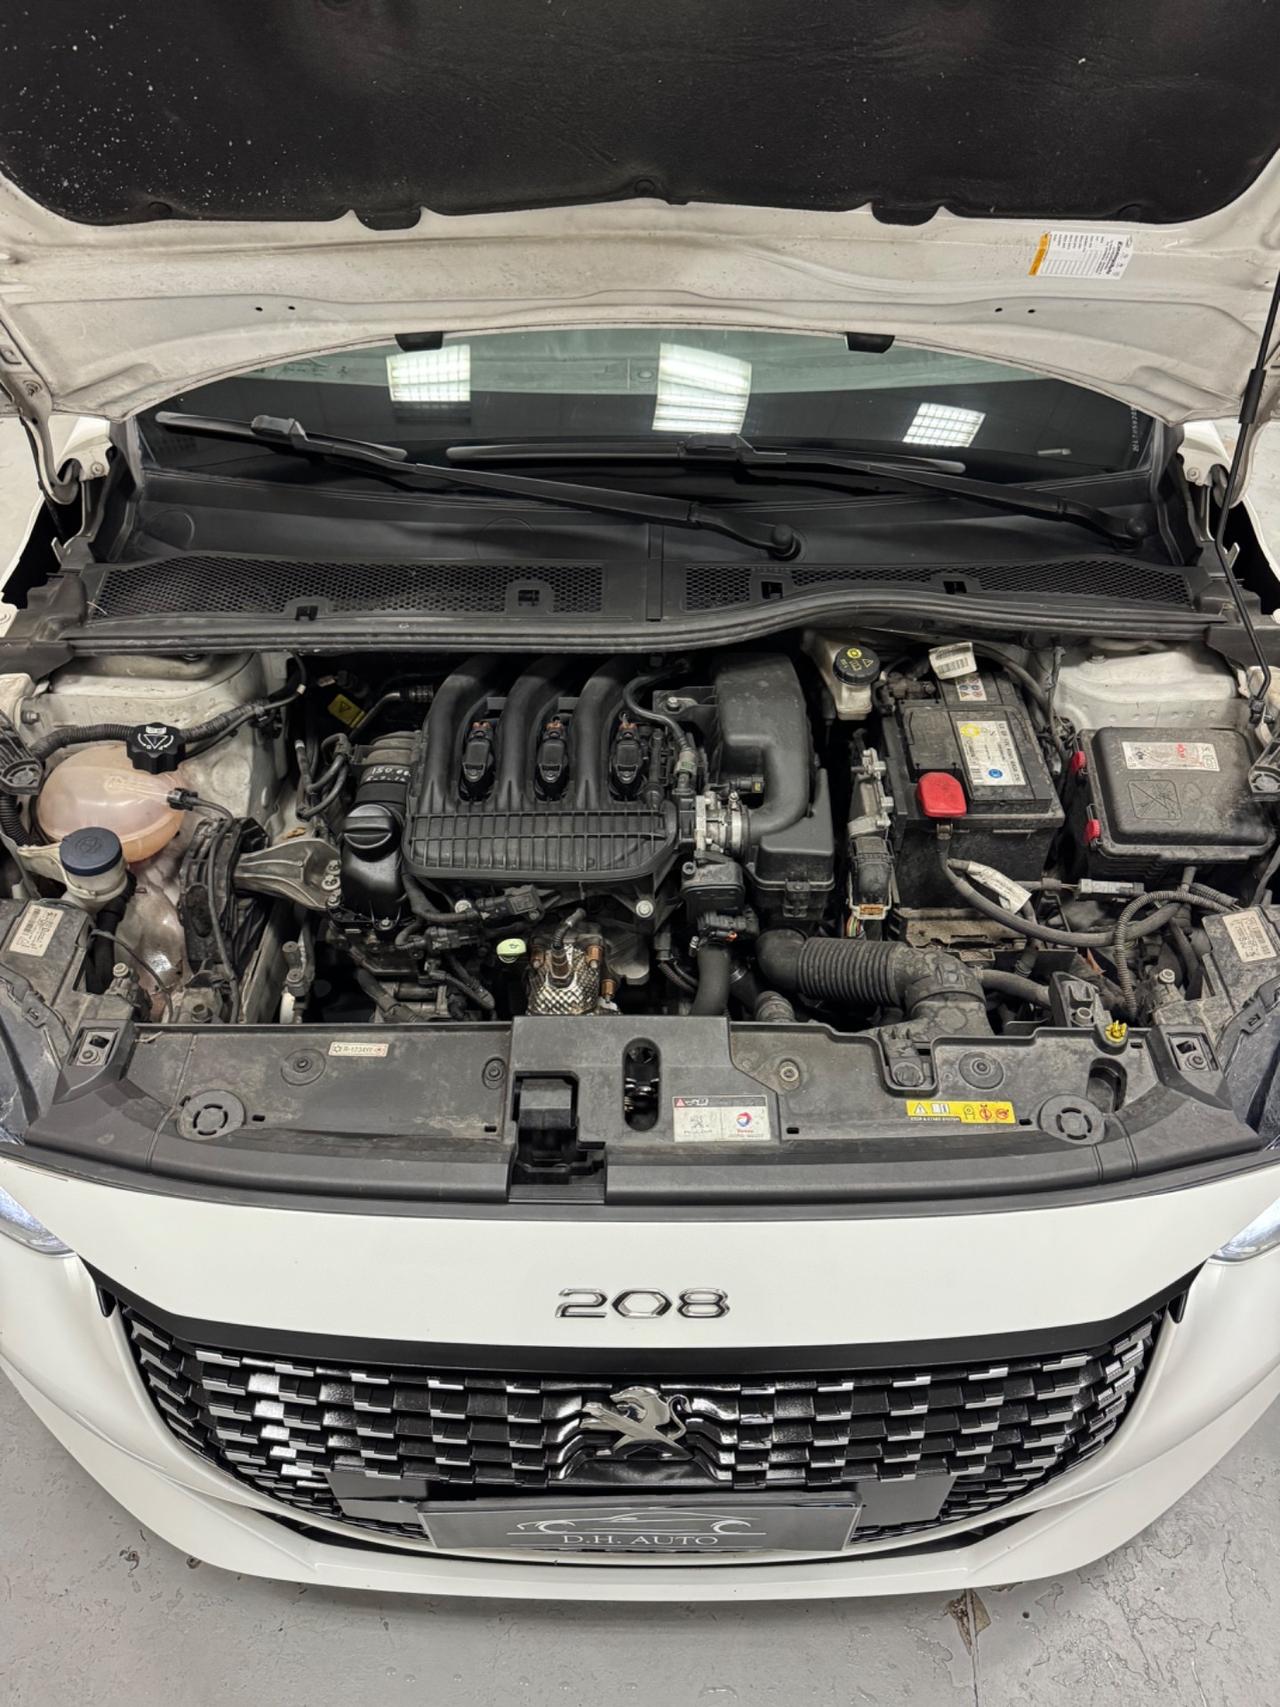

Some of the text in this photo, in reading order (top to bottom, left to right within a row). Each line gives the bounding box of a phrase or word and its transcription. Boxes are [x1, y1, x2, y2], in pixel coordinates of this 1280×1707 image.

[555, 1288, 730, 1318] 208
[563, 1535, 718, 1545] D.H. AUTO
